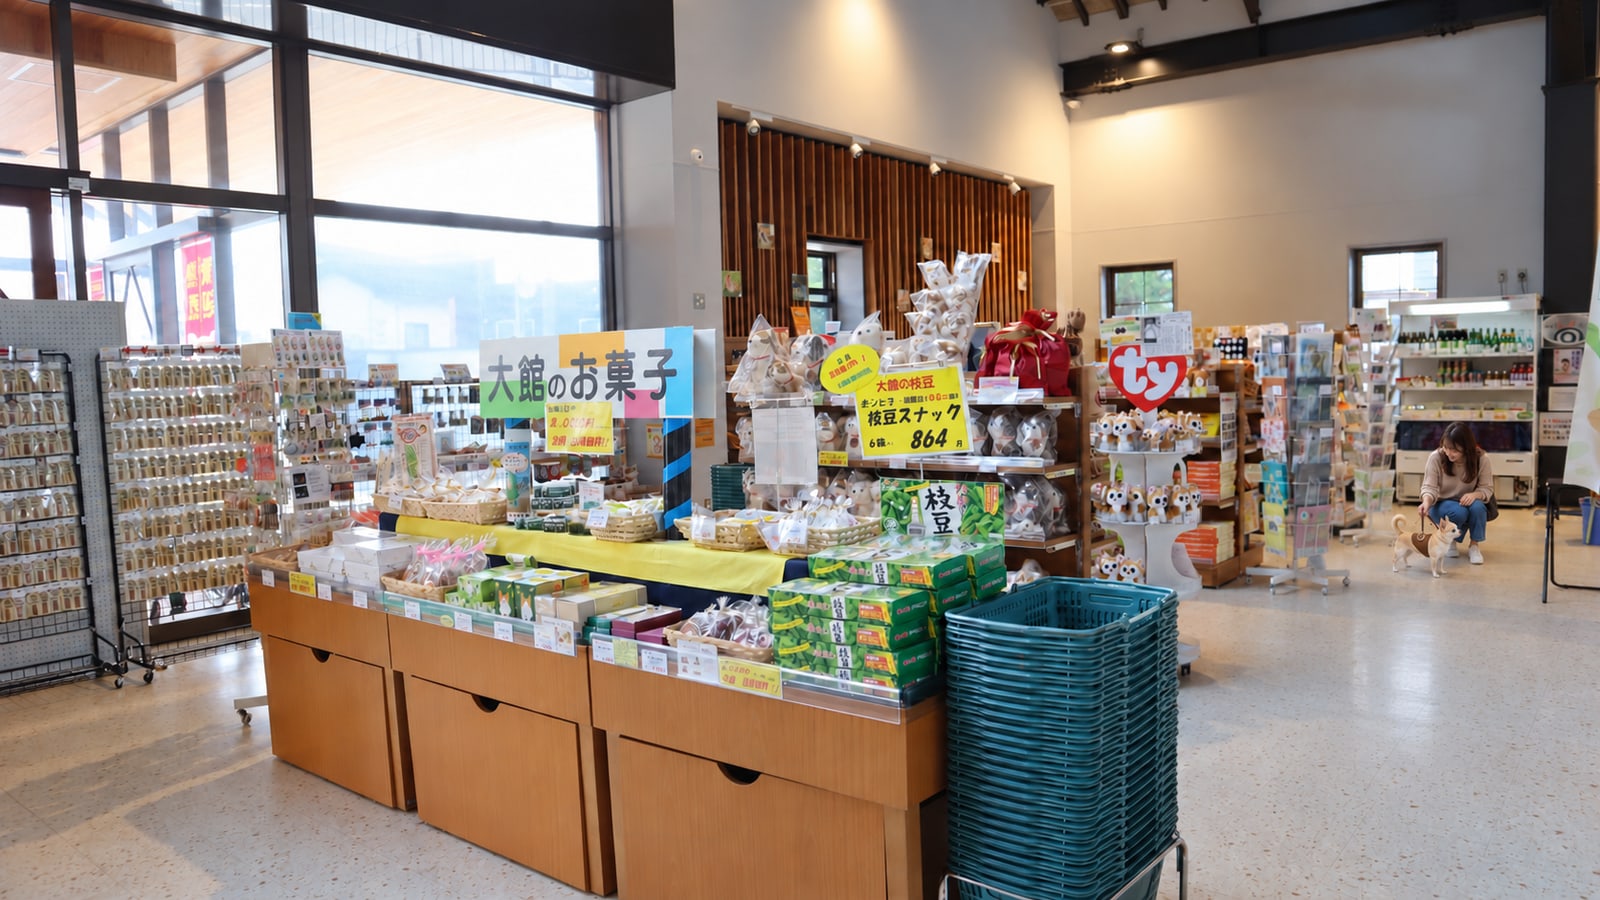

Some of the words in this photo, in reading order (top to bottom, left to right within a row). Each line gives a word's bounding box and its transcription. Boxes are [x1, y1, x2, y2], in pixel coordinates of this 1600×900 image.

[488, 349, 677, 403] 大館のお菓子
[1113, 347, 1178, 401] ty
[867, 403, 961, 427] 枝豆スナック
[911, 428, 948, 449] 864
[925, 485, 955, 534] 枝豆
